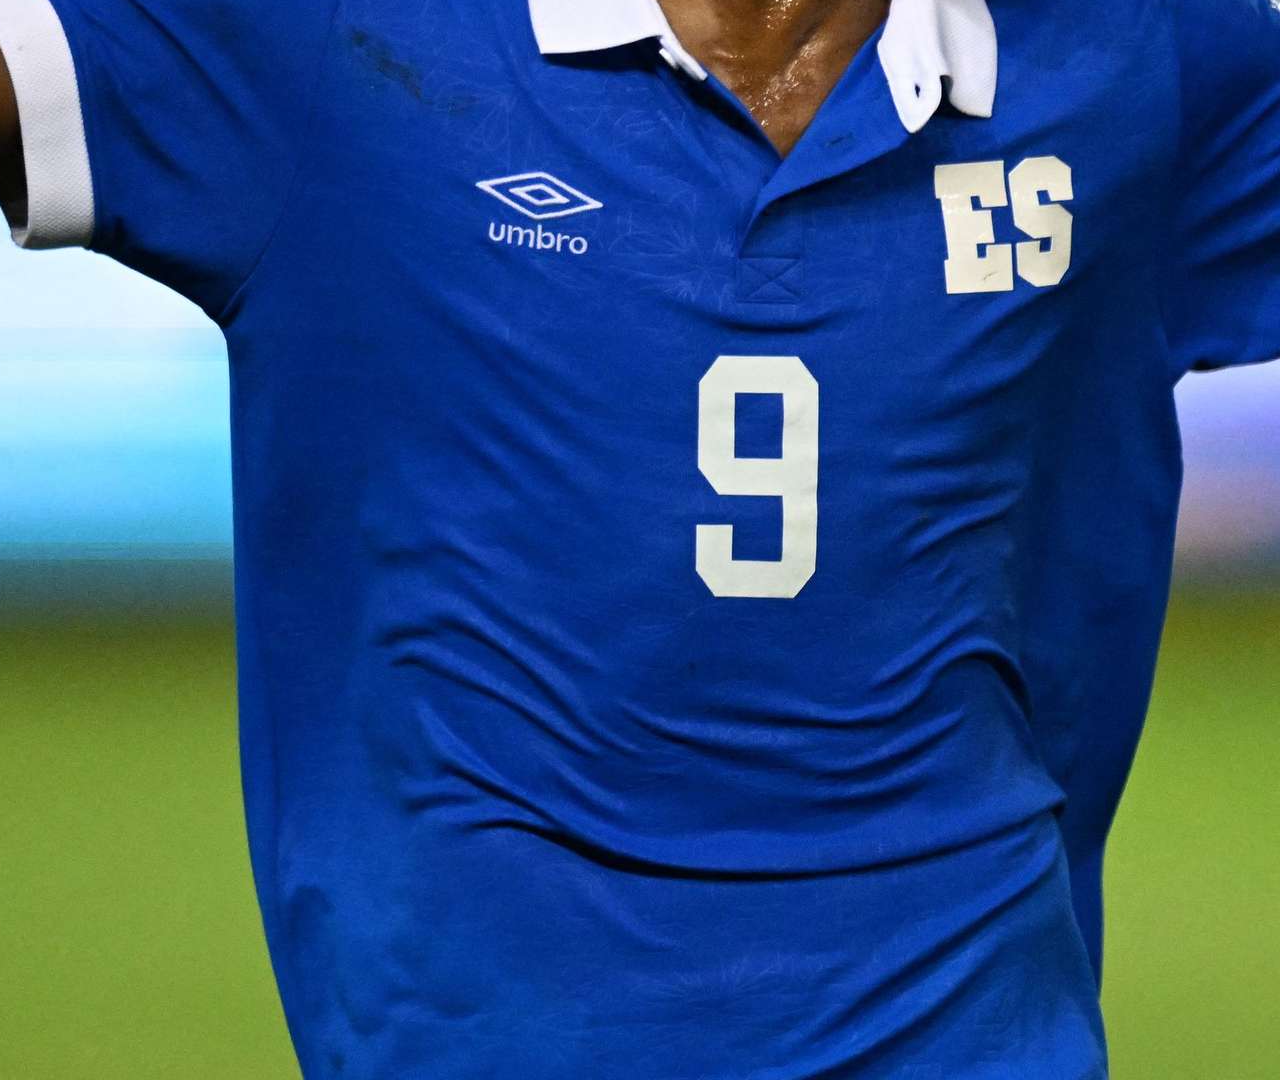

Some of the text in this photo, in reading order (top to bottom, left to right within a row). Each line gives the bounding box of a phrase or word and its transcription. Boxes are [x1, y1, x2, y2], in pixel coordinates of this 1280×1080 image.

[488, 221, 589, 255] umbro
[934, 155, 1074, 295] ES
[695, 355, 820, 599] 9
